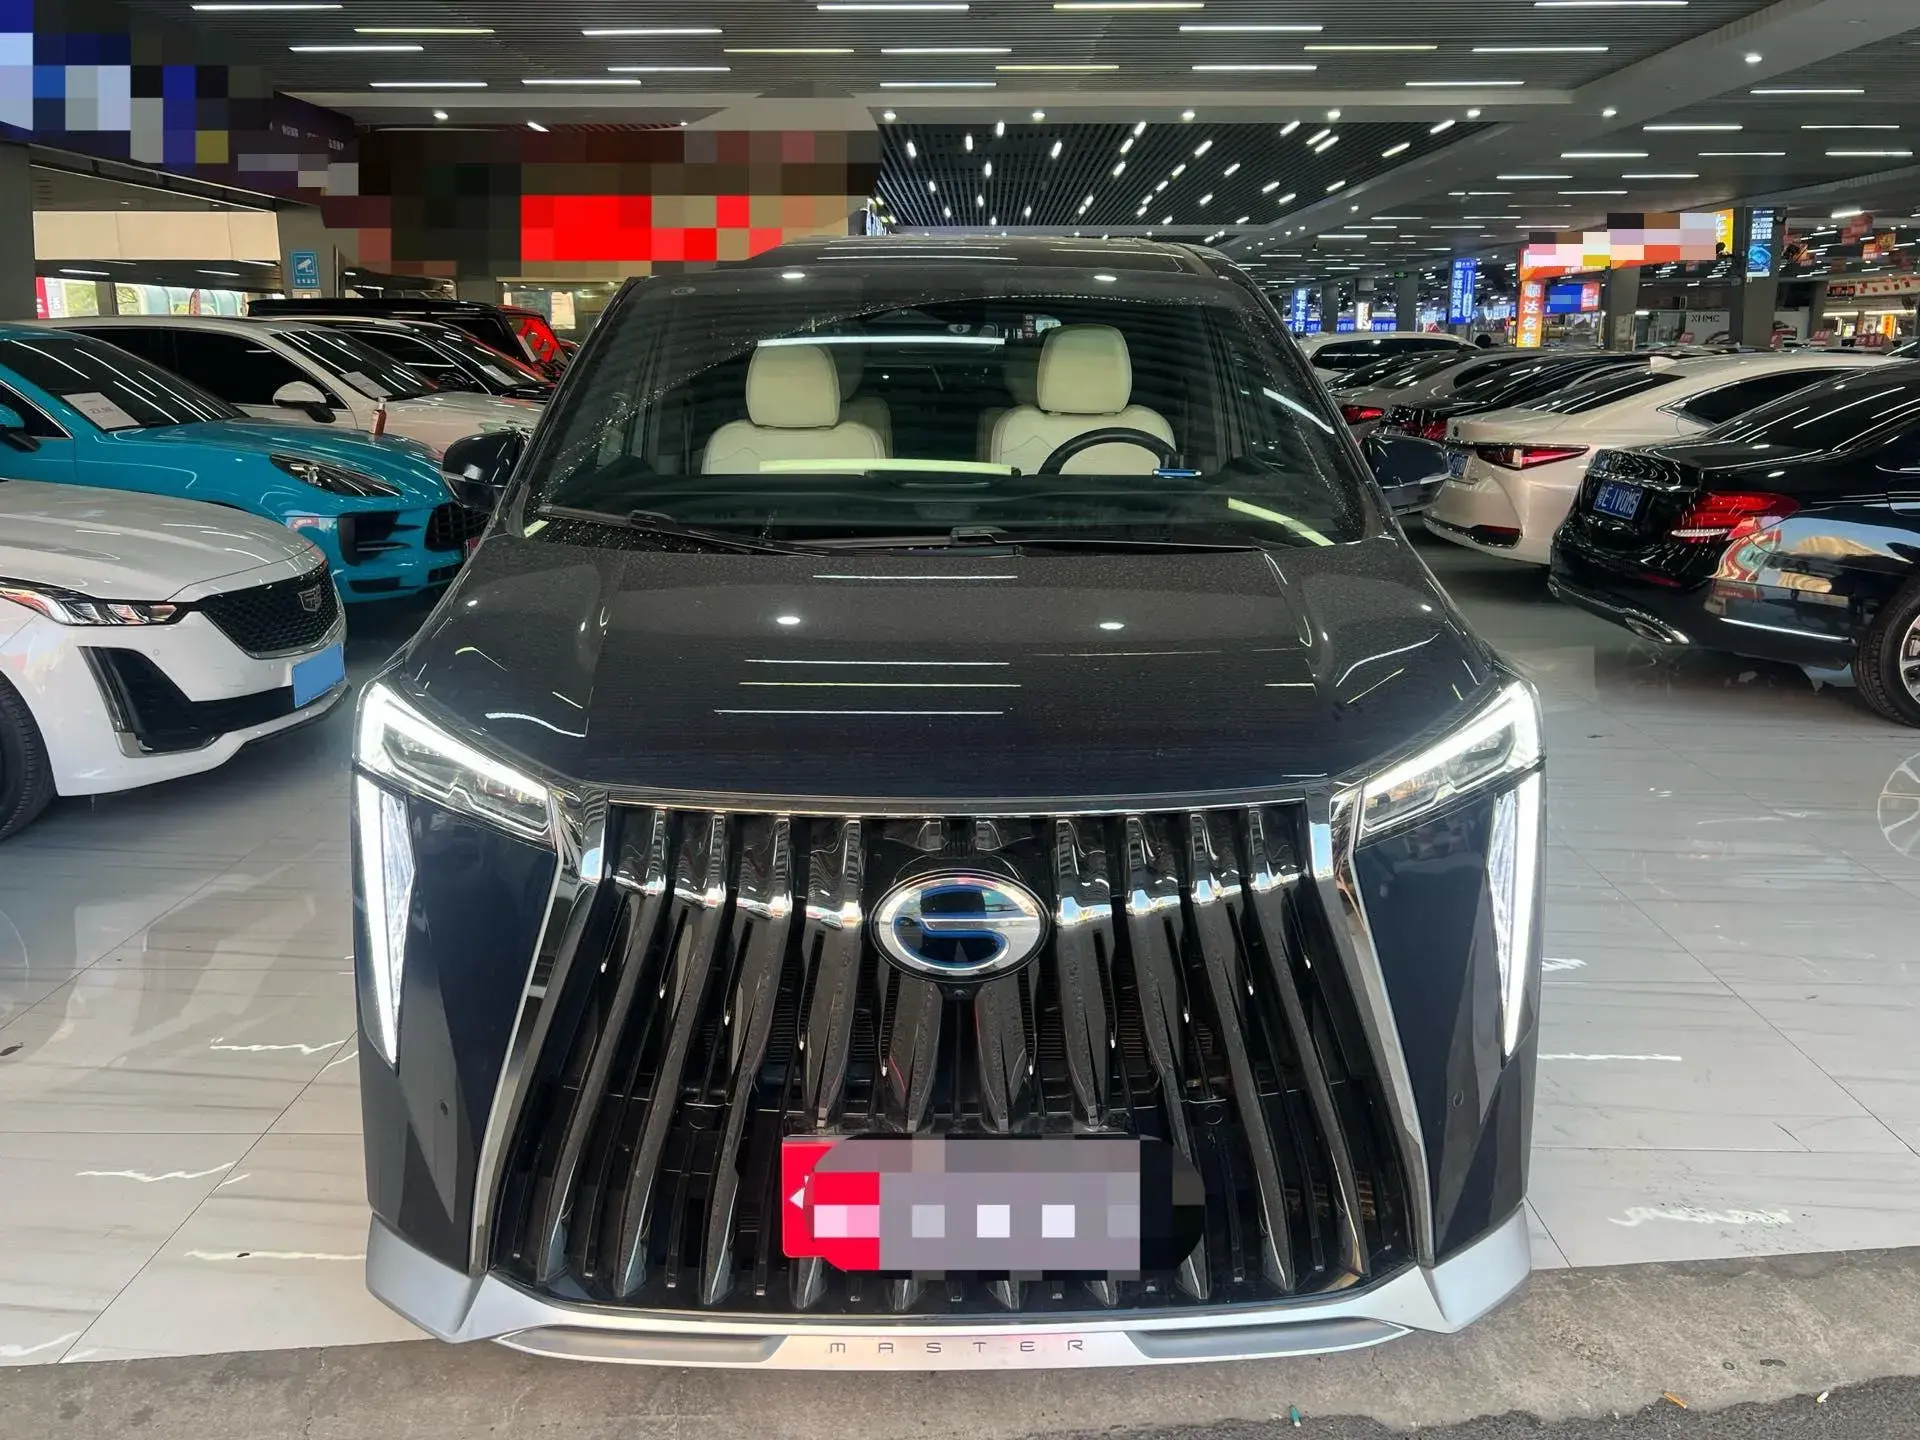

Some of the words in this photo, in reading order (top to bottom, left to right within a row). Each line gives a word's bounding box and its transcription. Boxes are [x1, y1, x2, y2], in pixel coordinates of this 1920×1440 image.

[1522, 284, 1541, 345] 顺达名车
[829, 1339, 1084, 1353] MASTER
